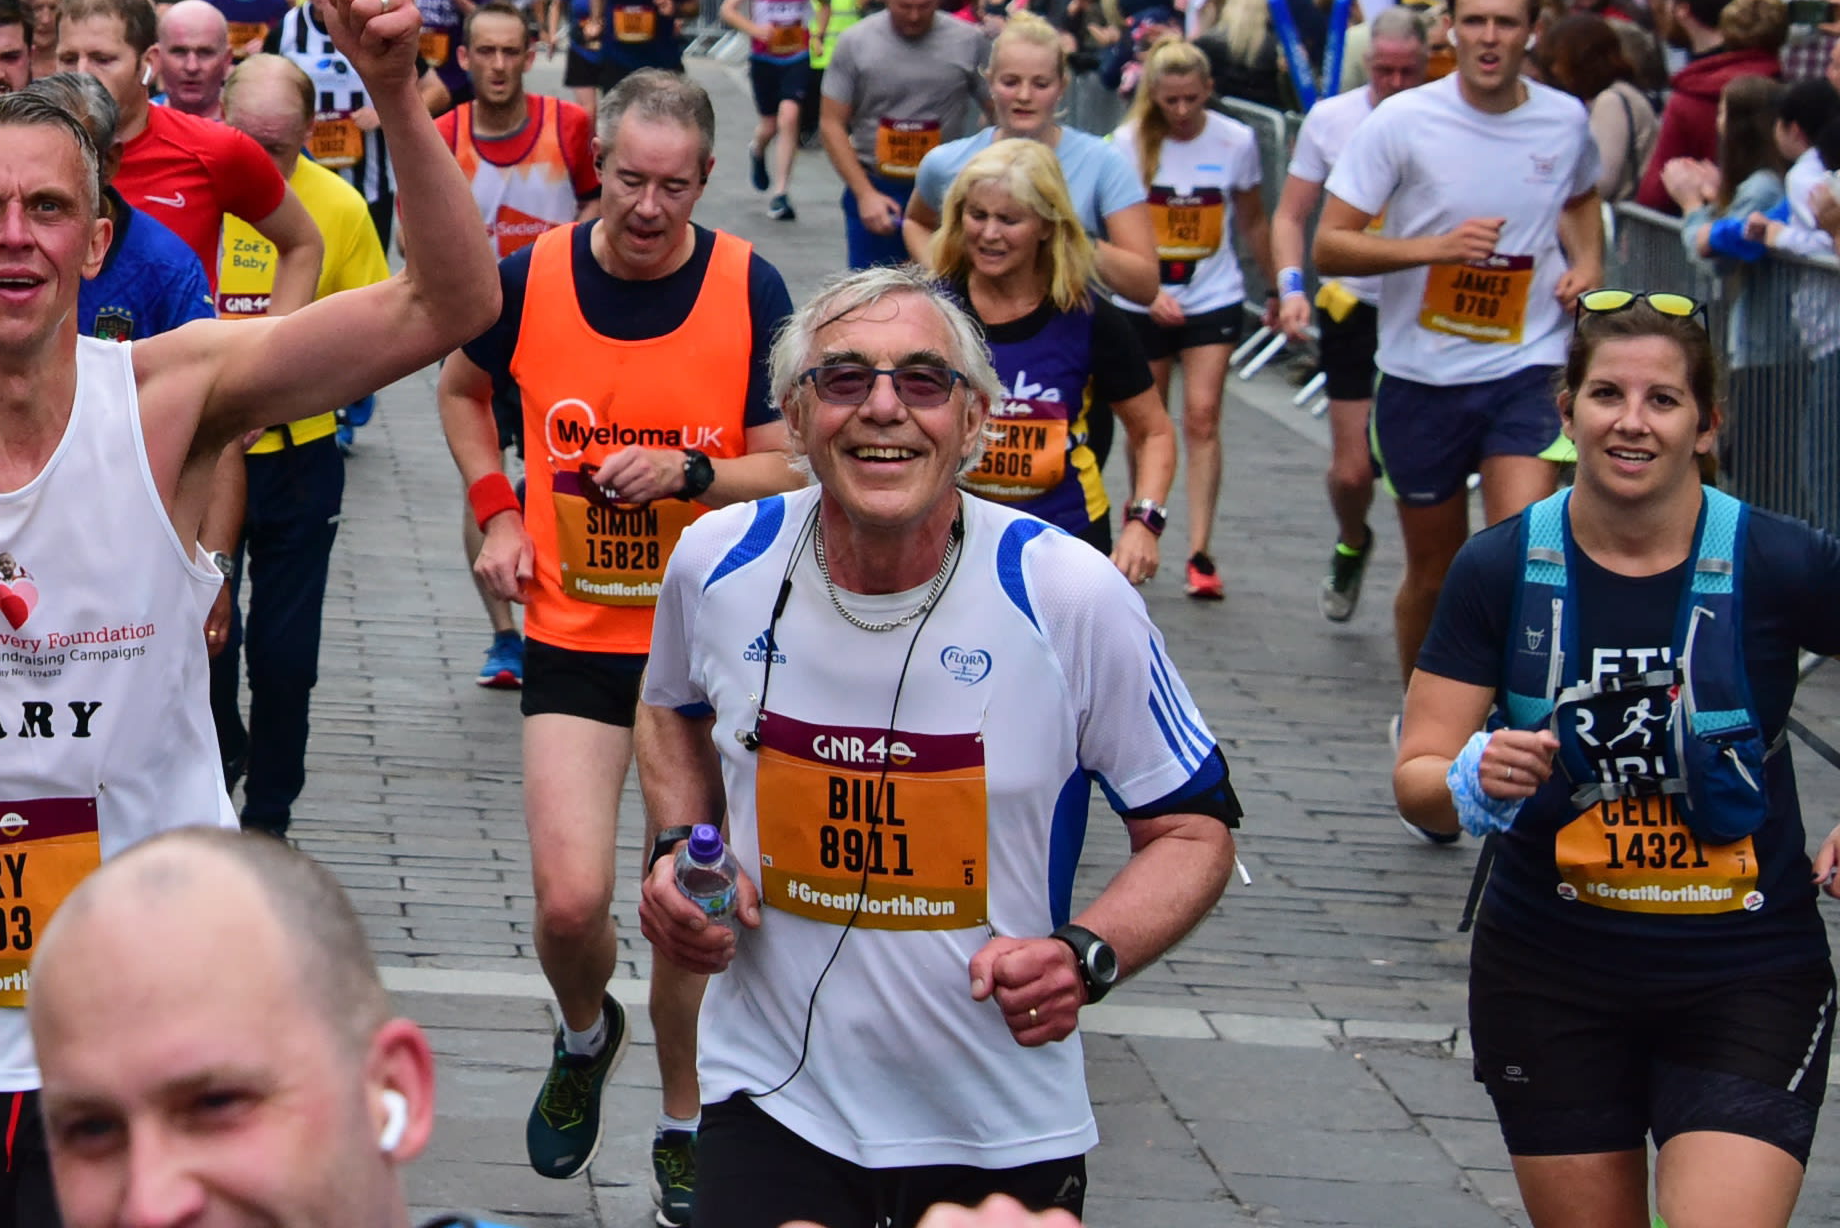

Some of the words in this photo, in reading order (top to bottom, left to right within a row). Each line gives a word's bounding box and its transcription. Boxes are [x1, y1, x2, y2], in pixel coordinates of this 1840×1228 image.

[232, 254, 268, 273] Baby
[1451, 271, 1512, 297] JAMES
[585, 505, 659, 538] SIMON
[585, 539, 660, 570] 15828
[47, 622, 156, 651] Foundation
[69, 644, 146, 662] Campaigns
[947, 650, 986, 667] FLORA
[828, 775, 906, 827] BILL
[1600, 794, 1681, 826] CELI
[819, 825, 915, 876] 8911
[1604, 831, 1709, 870] 14321
[964, 867, 975, 886] 5
[787, 879, 956, 916] #GreatNorthRun
[1585, 882, 1733, 903] #GreatNorthRun
